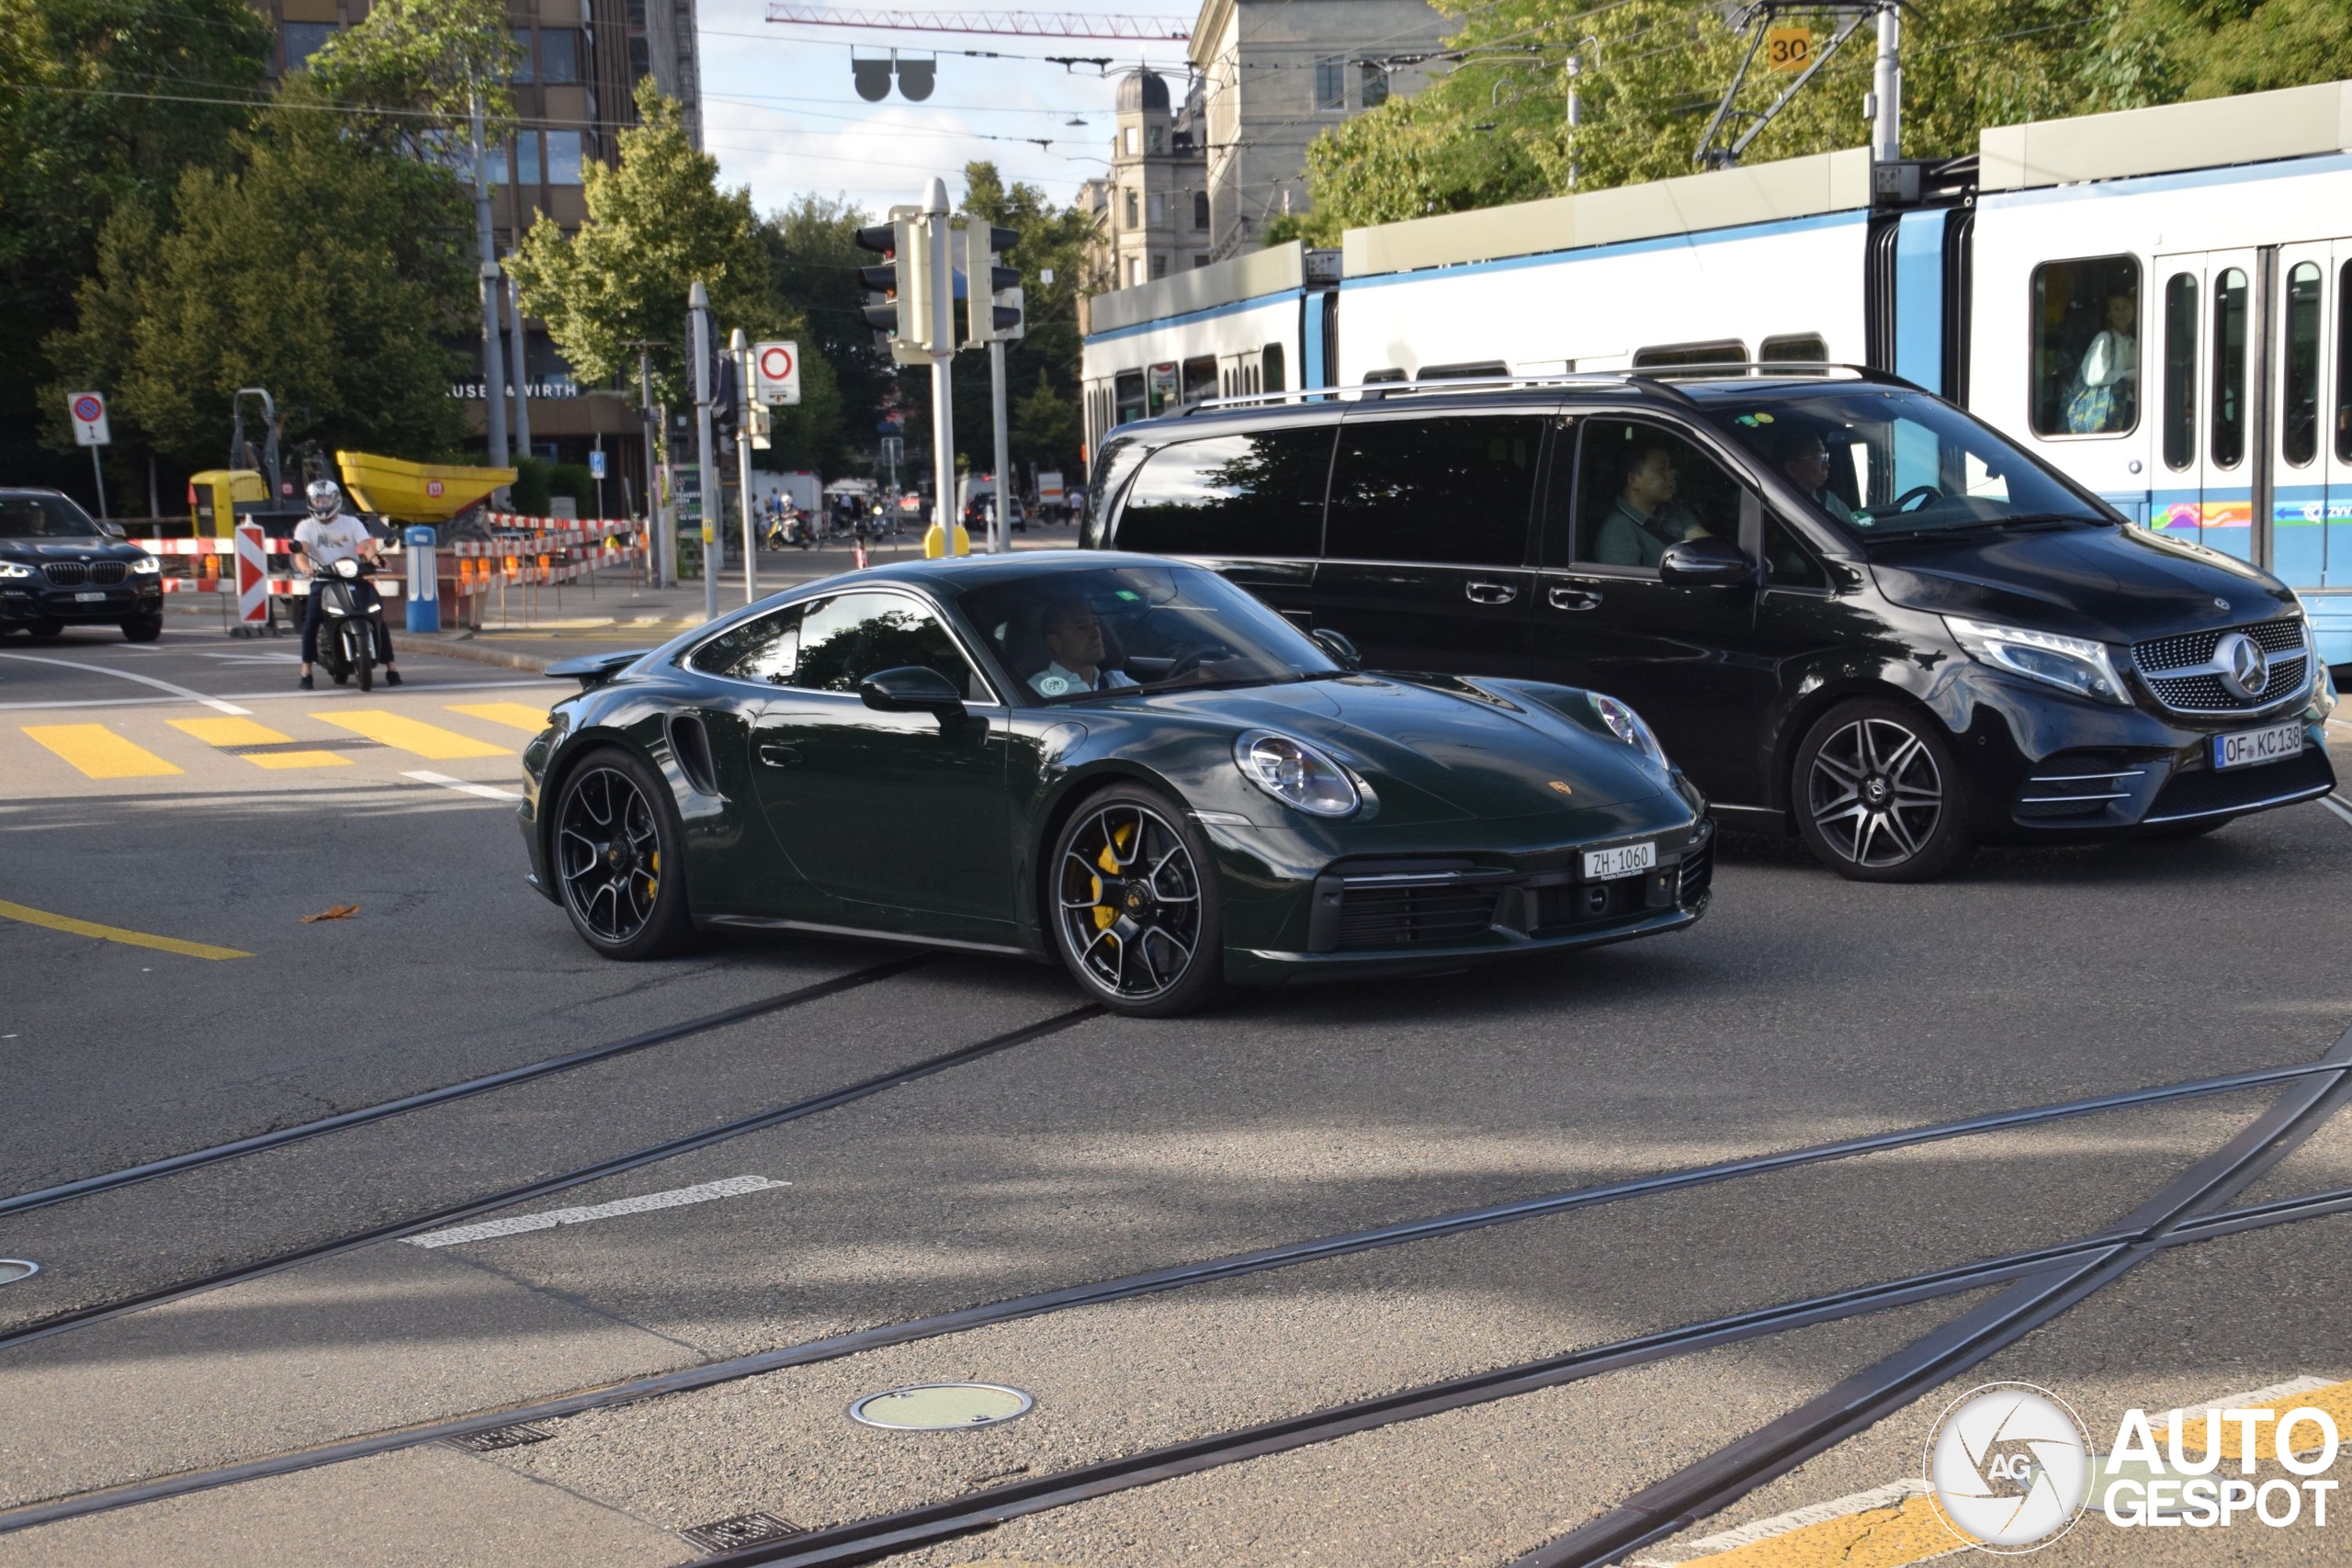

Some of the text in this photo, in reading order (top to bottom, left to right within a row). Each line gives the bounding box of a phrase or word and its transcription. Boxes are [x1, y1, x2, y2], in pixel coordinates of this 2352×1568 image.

[1773, 39, 1807, 62] 30
[505, 385, 514, 397] &
[2327, 506, 2352, 518] ZVV
[2226, 737, 2246, 762] OF
[2257, 731, 2276, 757] KC
[2278, 726, 2300, 752] 138
